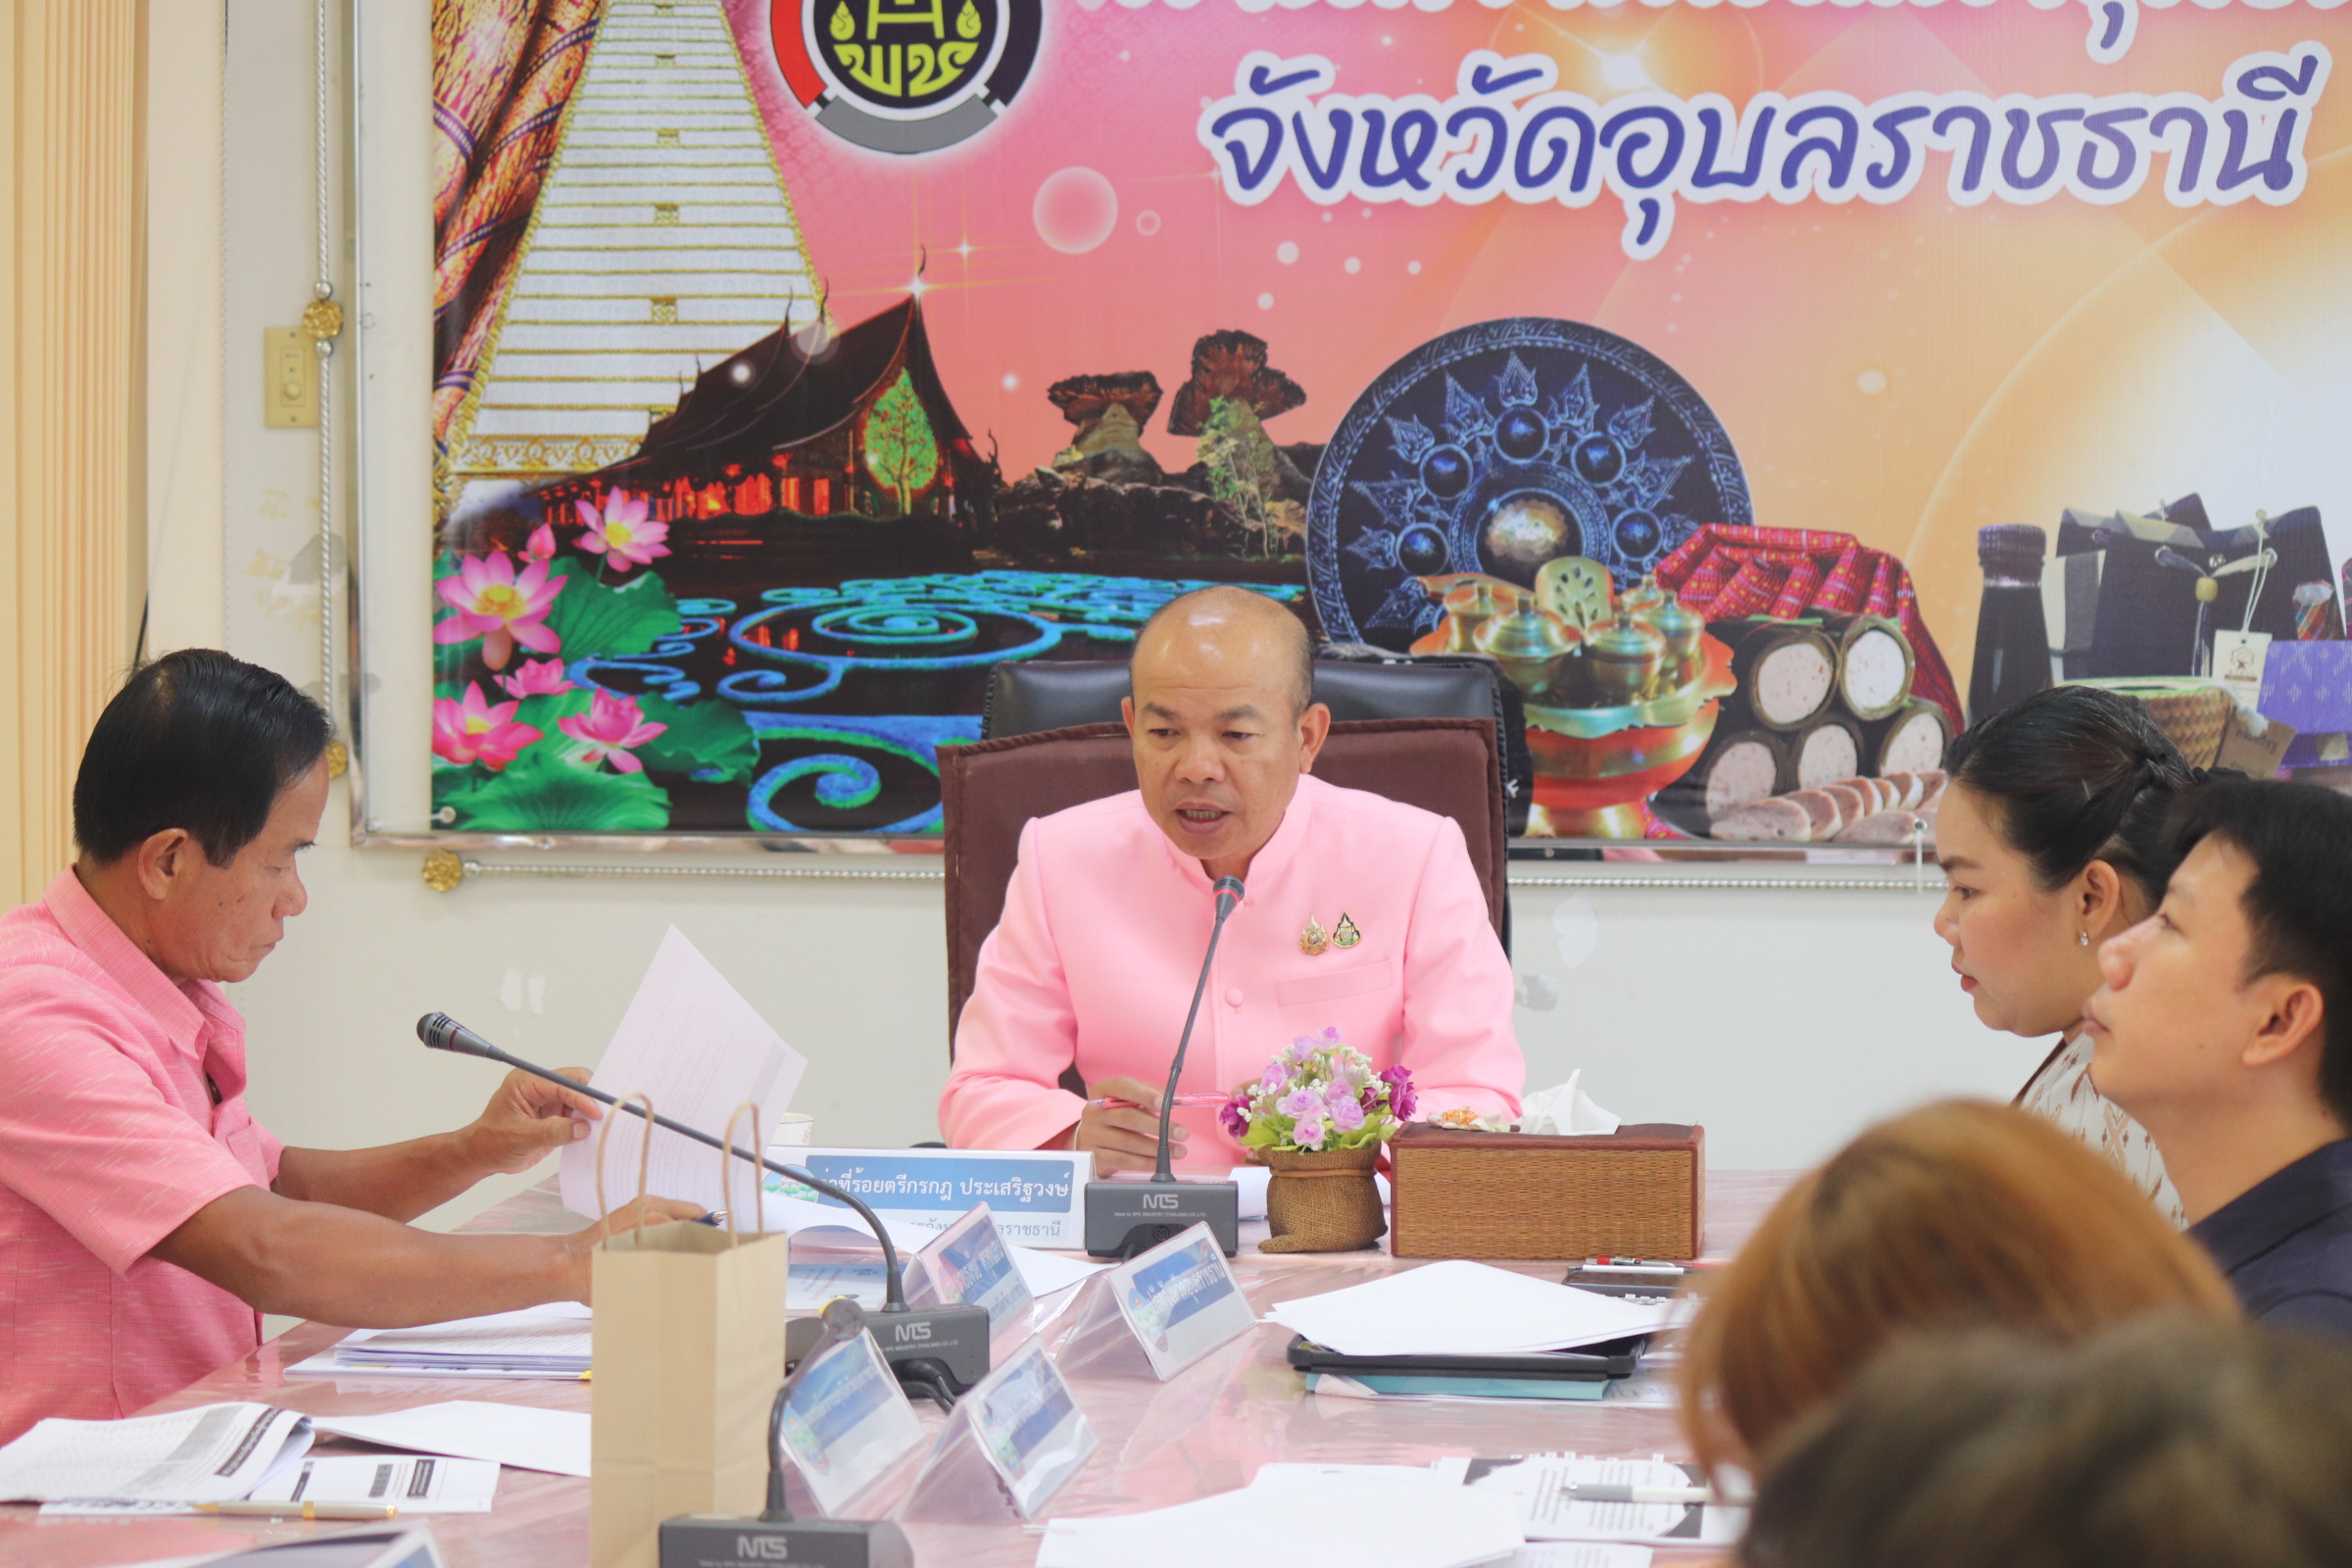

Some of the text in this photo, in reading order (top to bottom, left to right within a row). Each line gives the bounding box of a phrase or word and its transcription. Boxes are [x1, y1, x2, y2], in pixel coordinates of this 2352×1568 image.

[1210, 53, 2320, 247] จังหวัดอุบลราชธานี
[820, 1166, 1070, 1202] ่าที่ร้อยตรีกรกฎ ประเสริฐวงษ์
